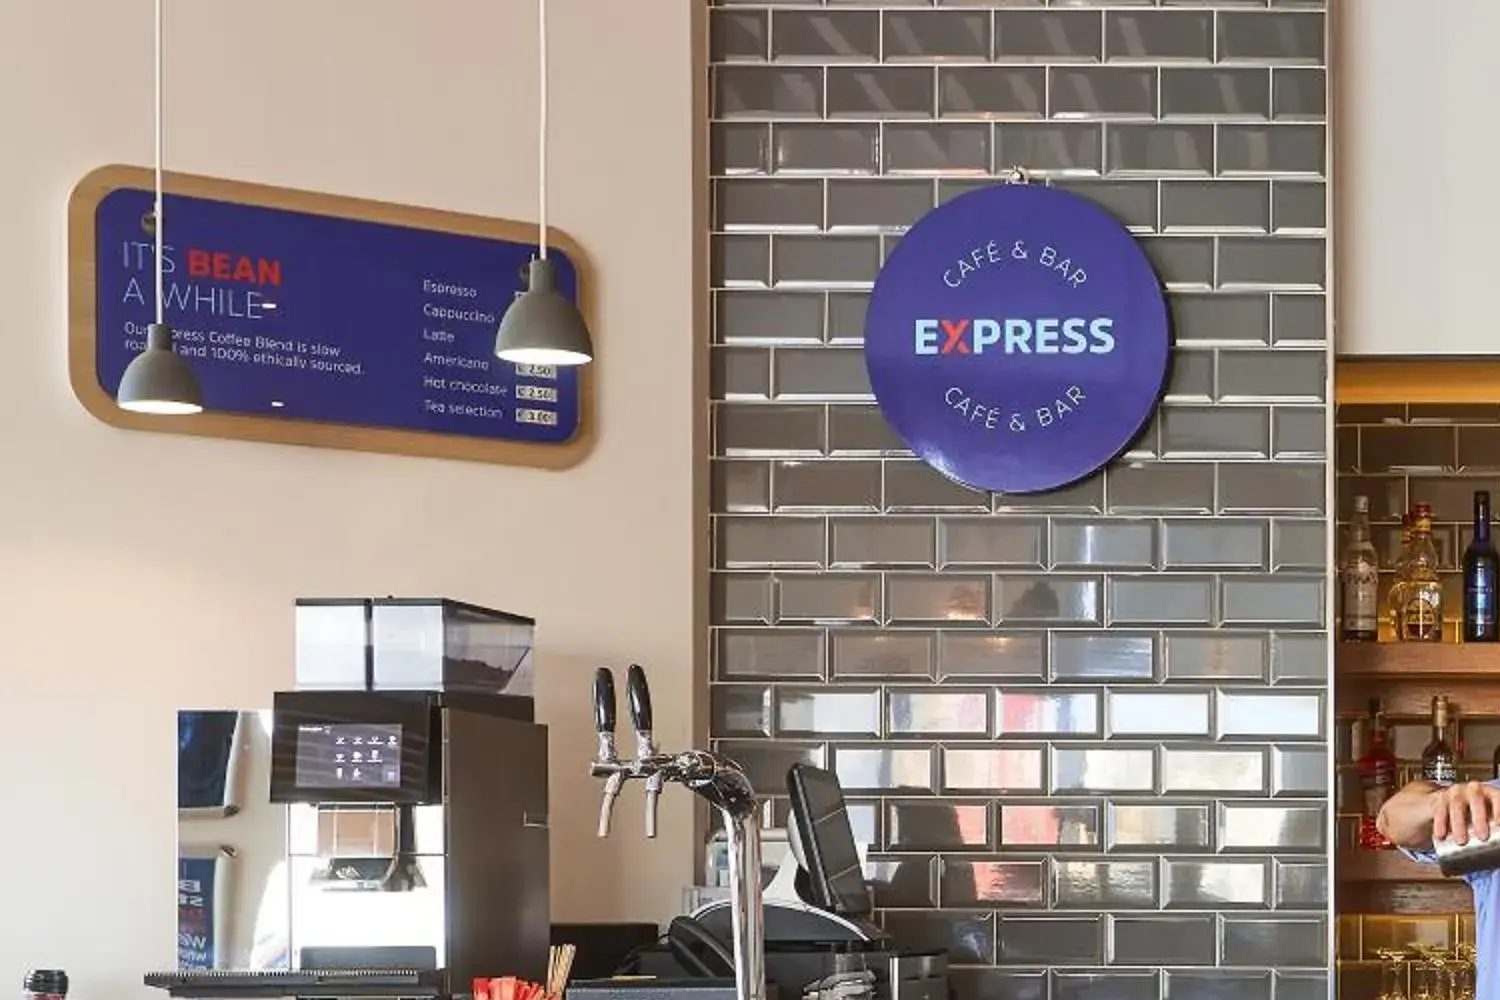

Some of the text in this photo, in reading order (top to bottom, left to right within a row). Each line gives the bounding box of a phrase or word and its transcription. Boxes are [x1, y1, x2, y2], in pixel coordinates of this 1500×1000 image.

[122, 241, 282, 286] IT'S BEAN
[943, 239, 1087, 288] CAFÉ & BAR
[123, 277, 263, 319] A WHILE
[423, 280, 477, 298] Espresso
[423, 303, 495, 323] Cappuccino
[209, 331, 251, 347] Coffee
[255, 335, 292, 351] Blend
[297, 341, 306, 353] is
[310, 341, 341, 356] slow
[423, 328, 455, 343] Latte
[914, 318, 1115, 355] EXPRESS
[179, 343, 207, 358] and
[211, 346, 250, 362] 100%
[253, 351, 308, 369] ethically
[424, 352, 489, 371] Americano
[423, 376, 507, 396] Hot chocolate
[424, 399, 503, 418] Tea selection
[1009, 413, 1025, 432] &
[1036, 385, 1086, 427] BAR
